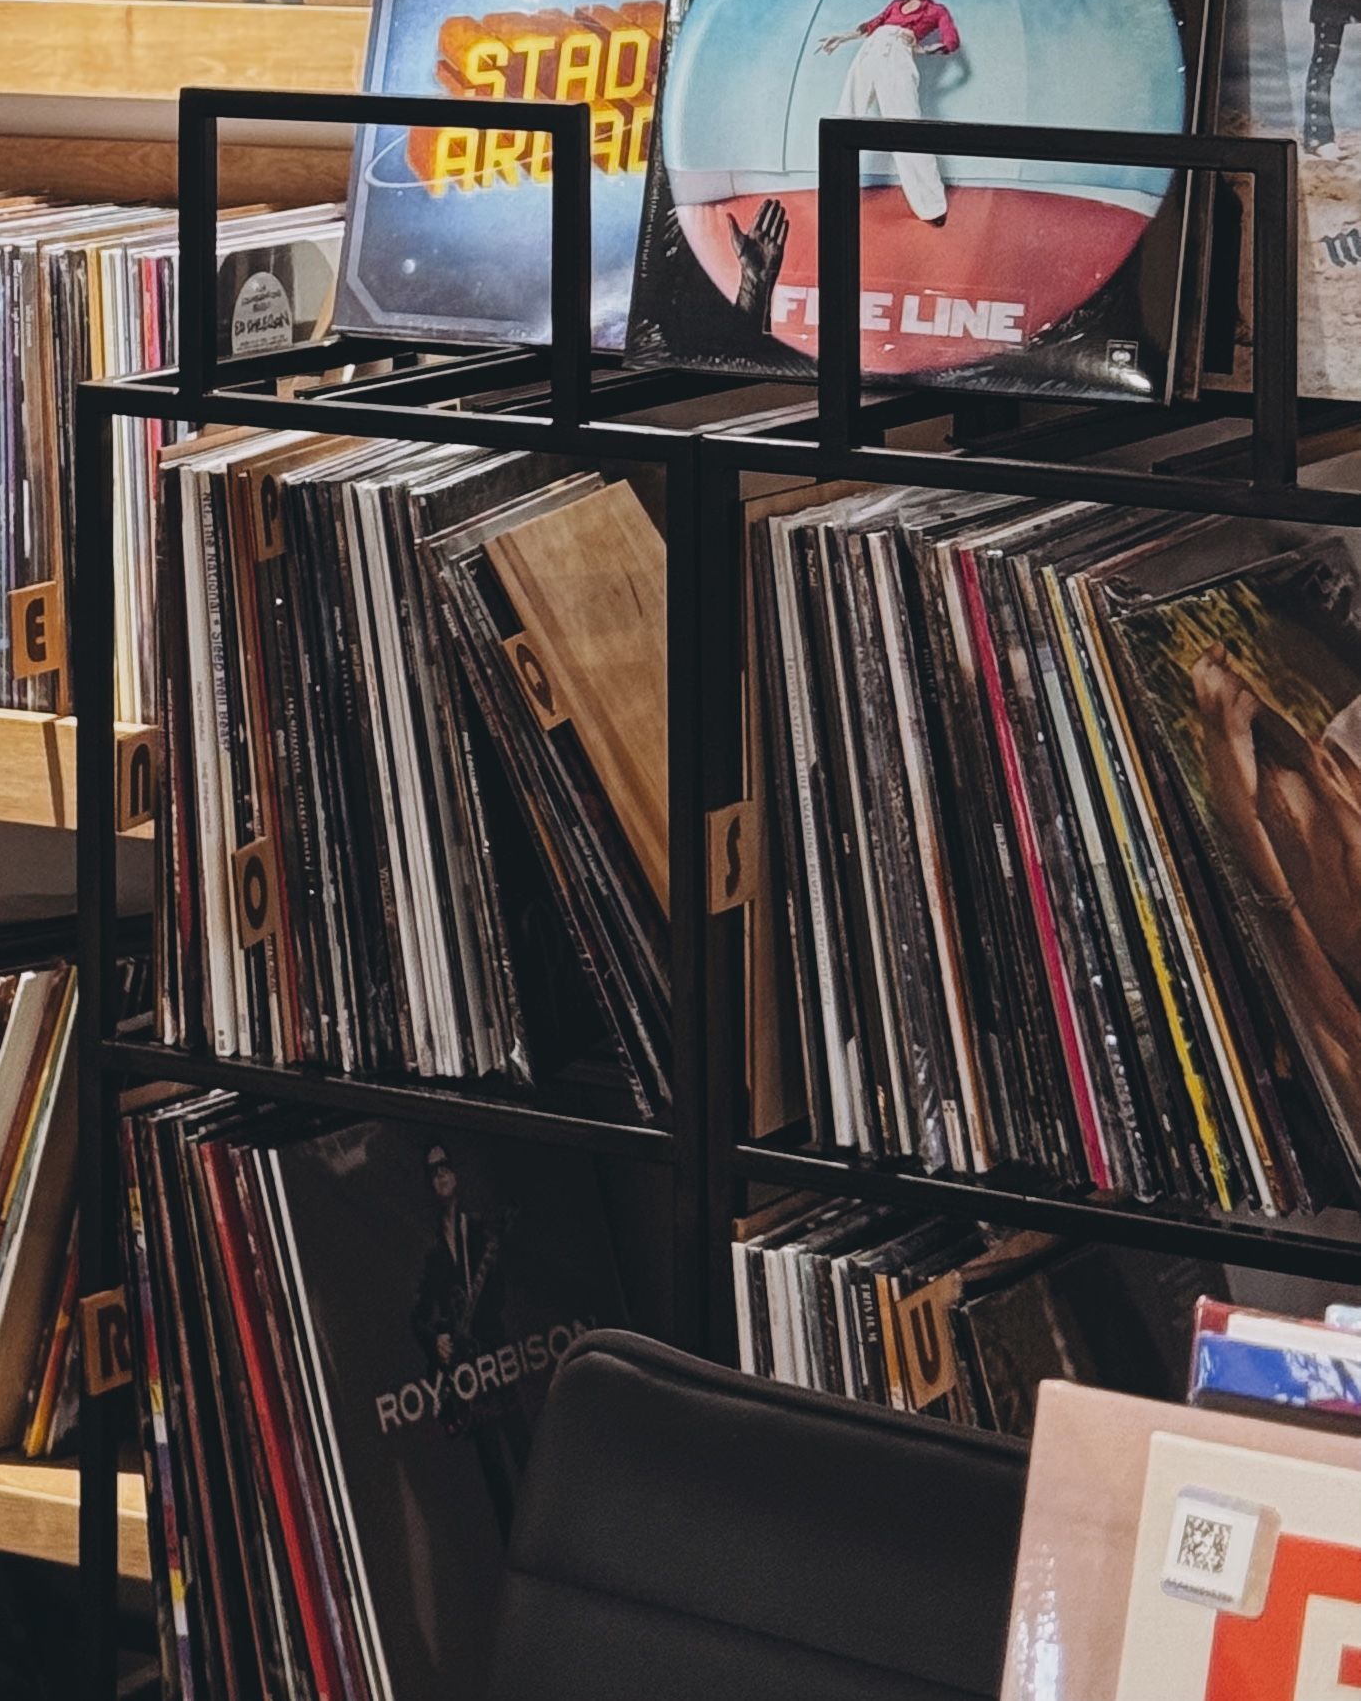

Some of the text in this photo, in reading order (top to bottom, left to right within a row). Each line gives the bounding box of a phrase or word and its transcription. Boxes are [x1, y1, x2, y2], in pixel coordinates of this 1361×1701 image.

[771, 284, 1025, 343] FIE LINE
[24, 597, 46, 663] E
[515, 641, 556, 715] Q
[242, 852, 269, 929] O
[906, 1297, 944, 1386] U
[375, 1368, 444, 1435] ROY
